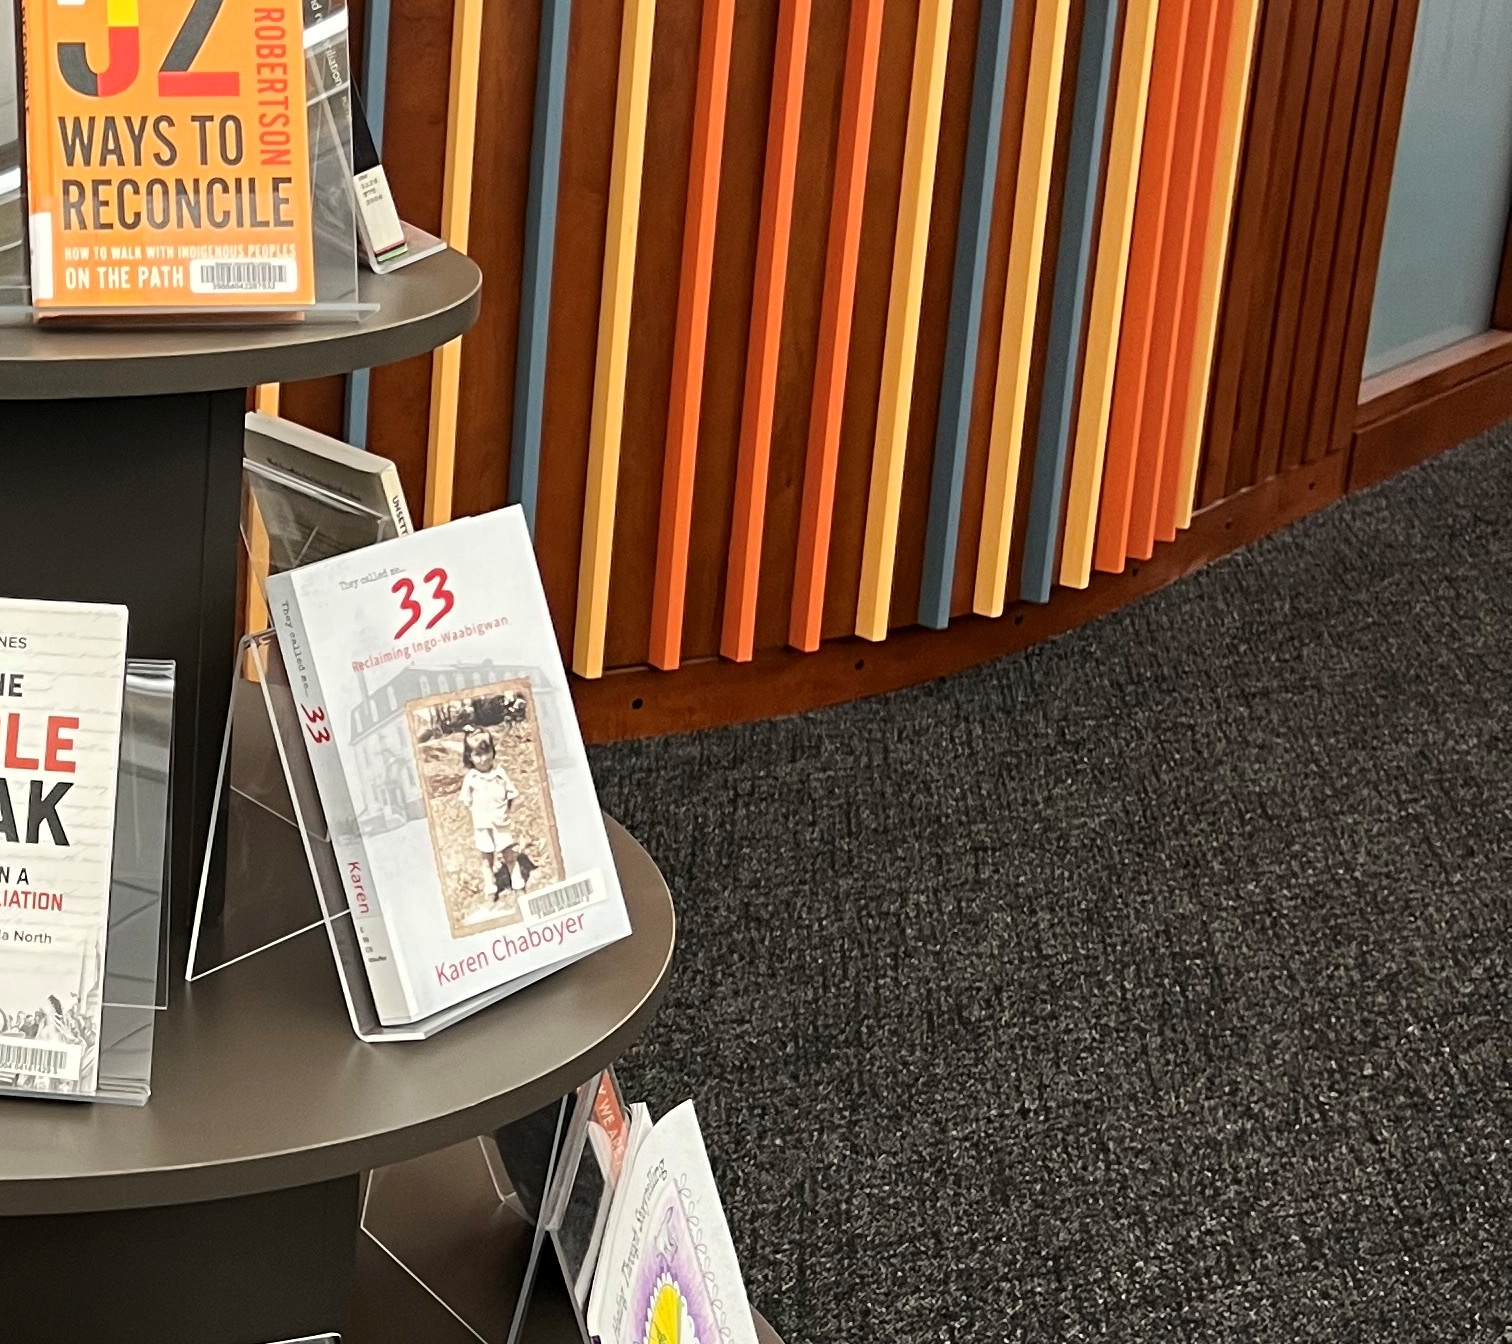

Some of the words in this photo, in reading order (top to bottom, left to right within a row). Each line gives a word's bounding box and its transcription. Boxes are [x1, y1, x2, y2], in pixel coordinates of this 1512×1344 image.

[254, 8, 292, 167] ROBERTSON
[58, 115, 178, 167] WAYS
[190, 114, 244, 166] TO
[62, 177, 295, 231] RECONCILE
[64, 245, 89, 260] HOW
[93, 245, 107, 260] TO
[111, 245, 142, 260] WALK
[145, 244, 175, 259] WITH
[177, 244, 245, 258] INDIGENOUS
[248, 243, 297, 258] PEOPLES
[65, 268, 89, 289] ON
[97, 267, 130, 288] THE
[138, 265, 184, 288] PATH
[339, 577, 359, 592] They
[360, 569, 388, 585] called
[391, 567, 455, 640] 33
[282, 600, 294, 630] They
[289, 631, 306, 673] called
[352, 644, 412, 673] Reclaiming
[412, 615, 510, 654] Ingo-Waabigwan
[301, 703, 331, 744] 33
[16, 867, 30, 885] A
[348, 861, 370, 914] Karen
[13, 929, 52, 945] North
[435, 948, 489, 987] Karen
[492, 912, 586, 963] Chaboyer
[598, 1098, 616, 1127] WE
